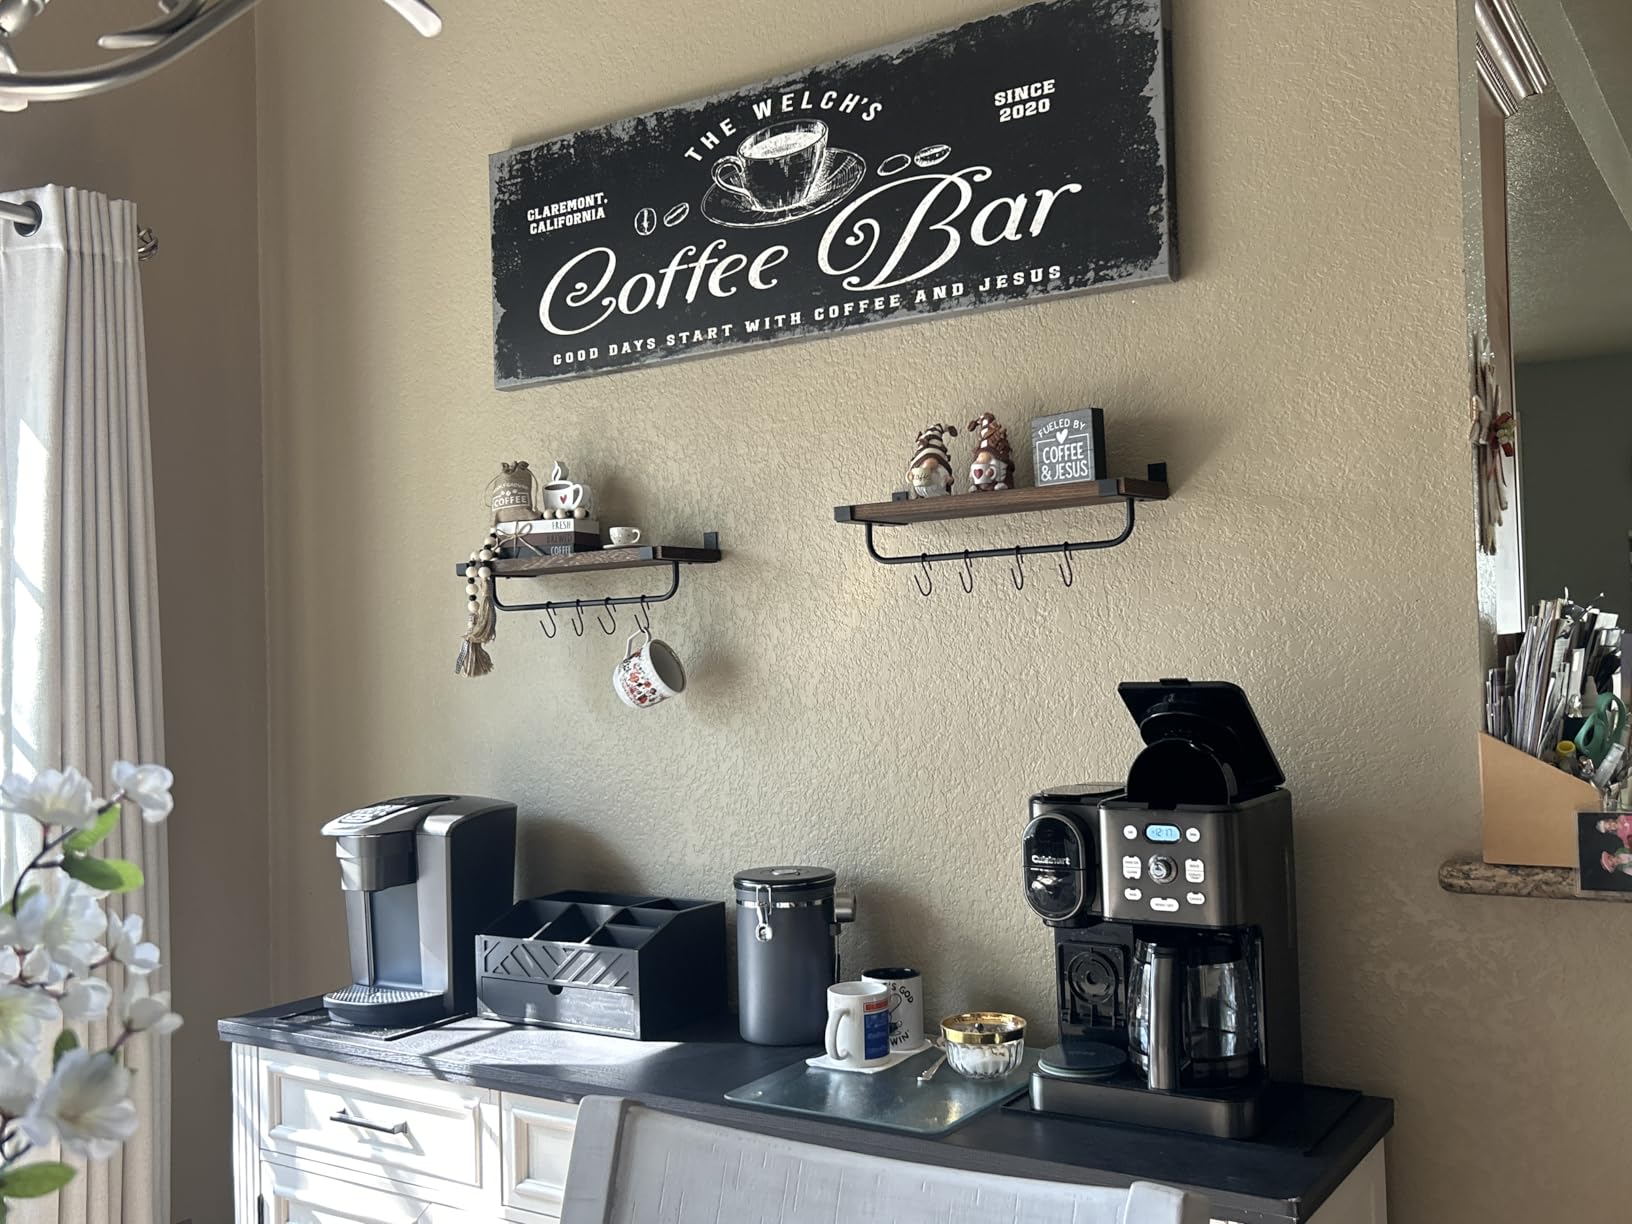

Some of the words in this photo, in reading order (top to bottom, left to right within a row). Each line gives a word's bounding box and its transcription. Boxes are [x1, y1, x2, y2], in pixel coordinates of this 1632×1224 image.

[994, 79, 1056, 106] SINCE
[999, 98, 1050, 122] 2020
[684, 117, 737, 162] THE
[752, 90, 883, 121] WELCH'S
[529, 206, 606, 235] CALIFORNIA
[539, 239, 789, 335] Coffee
[816, 165, 1083, 292] Bar
[553, 347, 599, 366] GOOD
[608, 337, 656, 356] DAYS
[666, 323, 733, 346] START
[744, 311, 802, 333] WITH
[814, 294, 901, 321] COFFEE
[914, 282, 964, 304] AND
[978, 265, 1062, 292] JESUS
[1038, 418, 1070, 438] FUELED
[1073, 419, 1086, 431] BY
[1042, 441, 1085, 464] COFFEE
[1040, 465, 1052, 481] &
[1053, 460, 1088, 480] JESUS
[494, 495, 527, 507] COFFEE
[551, 520, 571, 530] FRESH
[1031, 855, 1071, 865] Cuisinart
[899, 985, 914, 1003] GOD
